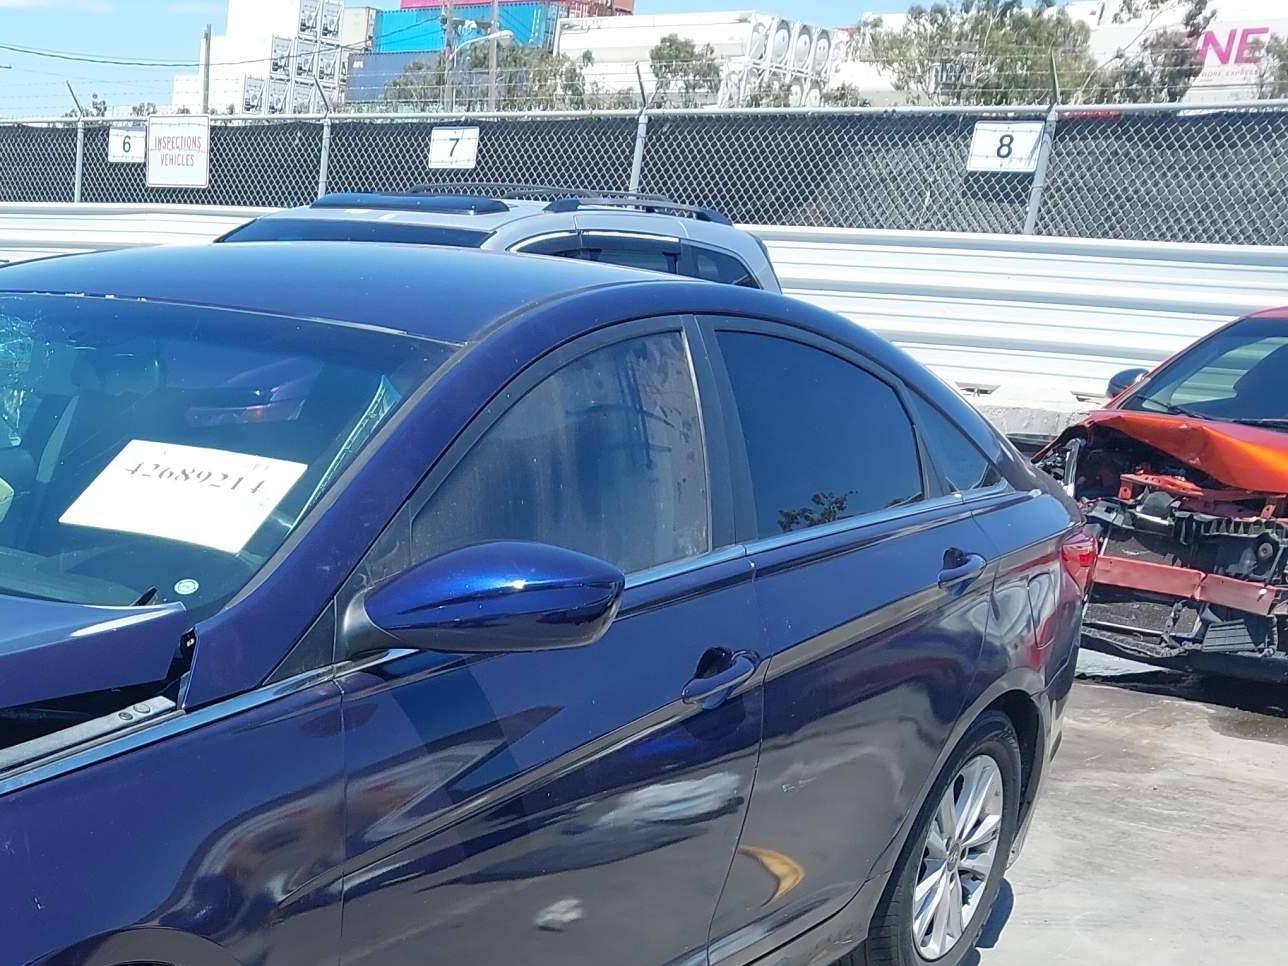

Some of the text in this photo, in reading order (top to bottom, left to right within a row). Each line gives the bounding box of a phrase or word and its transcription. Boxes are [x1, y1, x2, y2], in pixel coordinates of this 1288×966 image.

[1196, 27, 1270, 65] NE
[122, 135, 132, 153] 6
[154, 136, 202, 151] INSPECTIONS
[449, 138, 460, 157] 7
[997, 134, 1014, 159] 8
[160, 153, 195, 168] VEHICLES
[124, 461, 267, 494] 42689214
